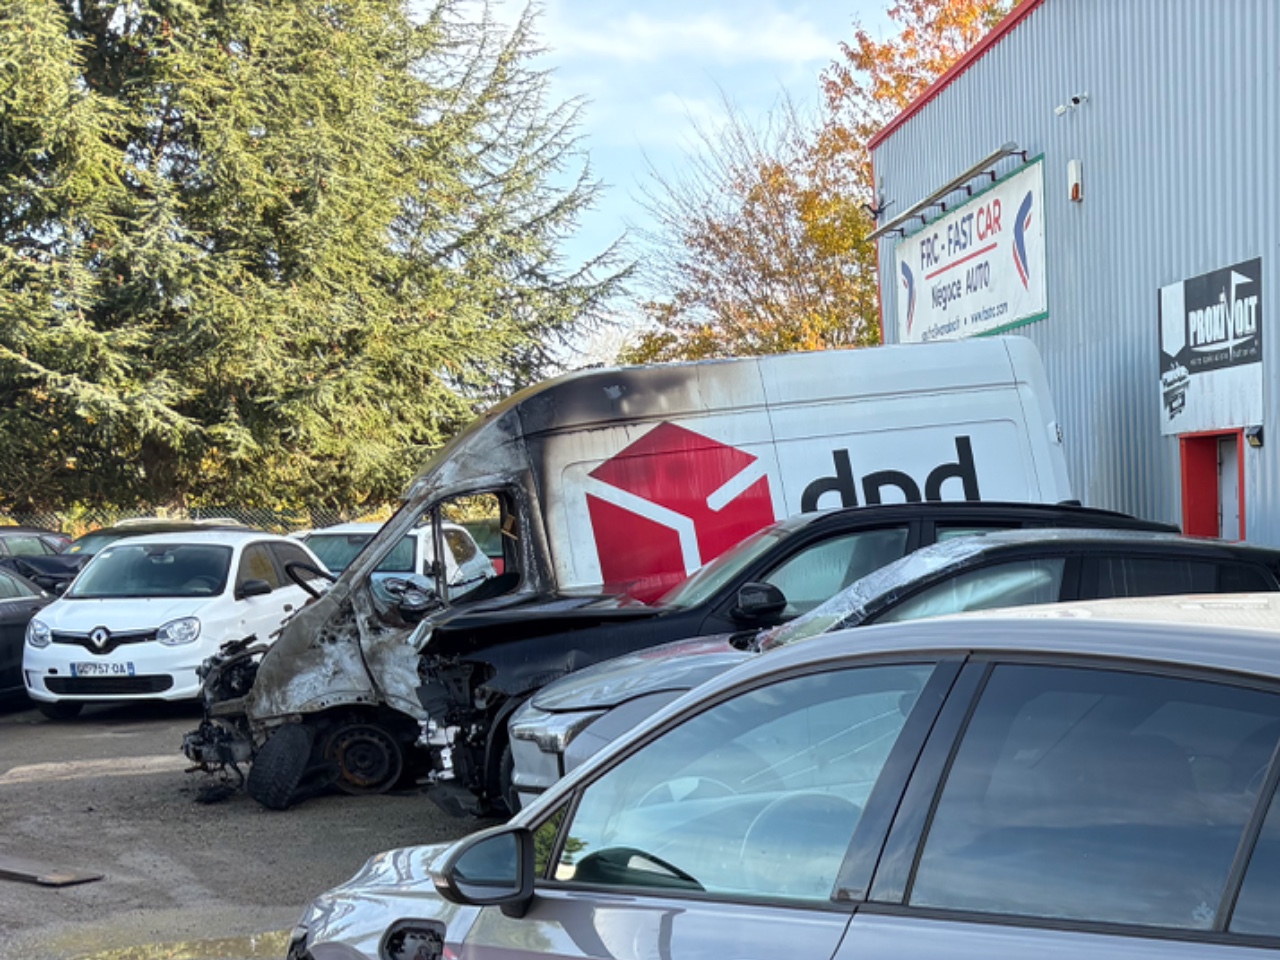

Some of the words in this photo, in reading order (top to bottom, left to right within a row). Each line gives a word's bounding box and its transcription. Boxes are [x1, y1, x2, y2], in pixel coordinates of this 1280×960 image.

[919, 232, 940, 271] FRC
[947, 212, 975, 258] FAST
[976, 198, 1003, 241] CAR
[965, 260, 990, 296] AUTO
